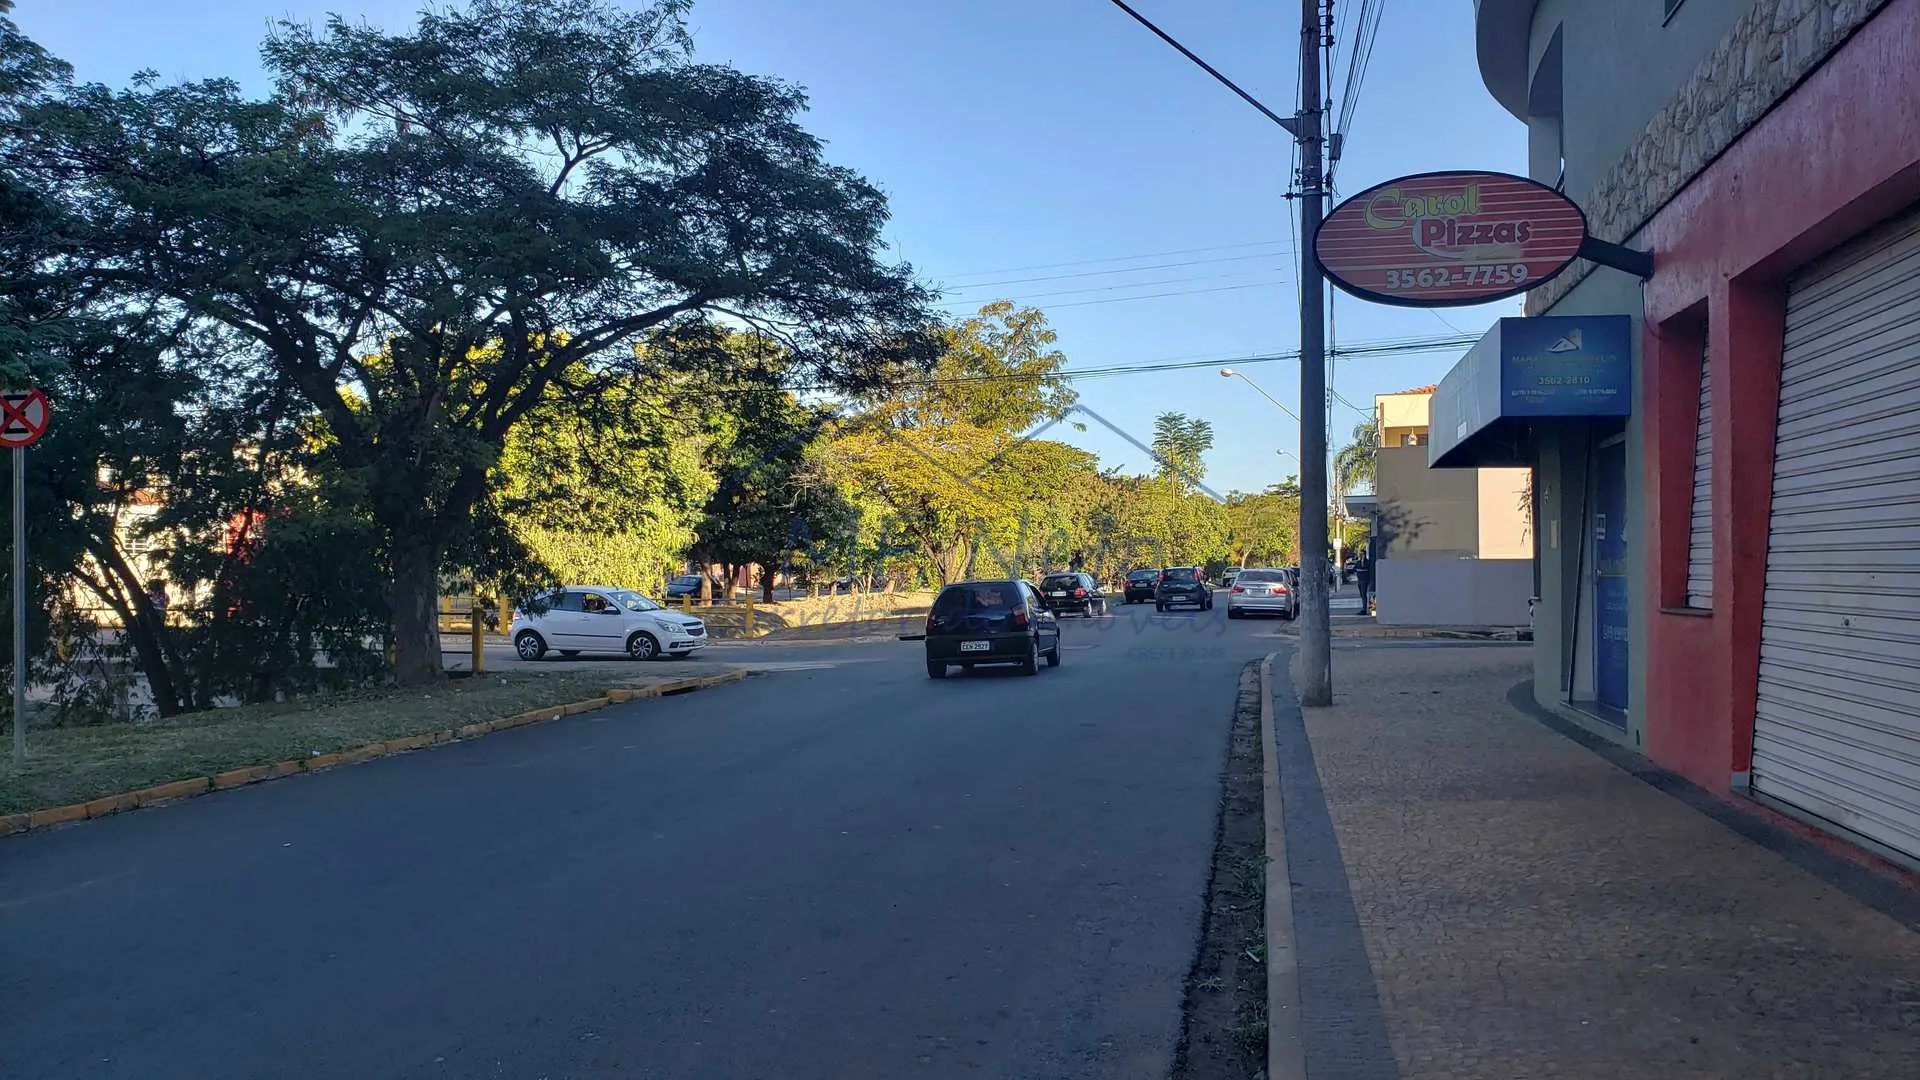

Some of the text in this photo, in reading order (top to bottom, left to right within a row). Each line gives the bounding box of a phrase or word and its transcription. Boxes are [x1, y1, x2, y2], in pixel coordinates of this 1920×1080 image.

[1364, 185, 1481, 230] Carol
[1420, 217, 1533, 248] Pizzas
[1386, 263, 1530, 290] 3562-7759
